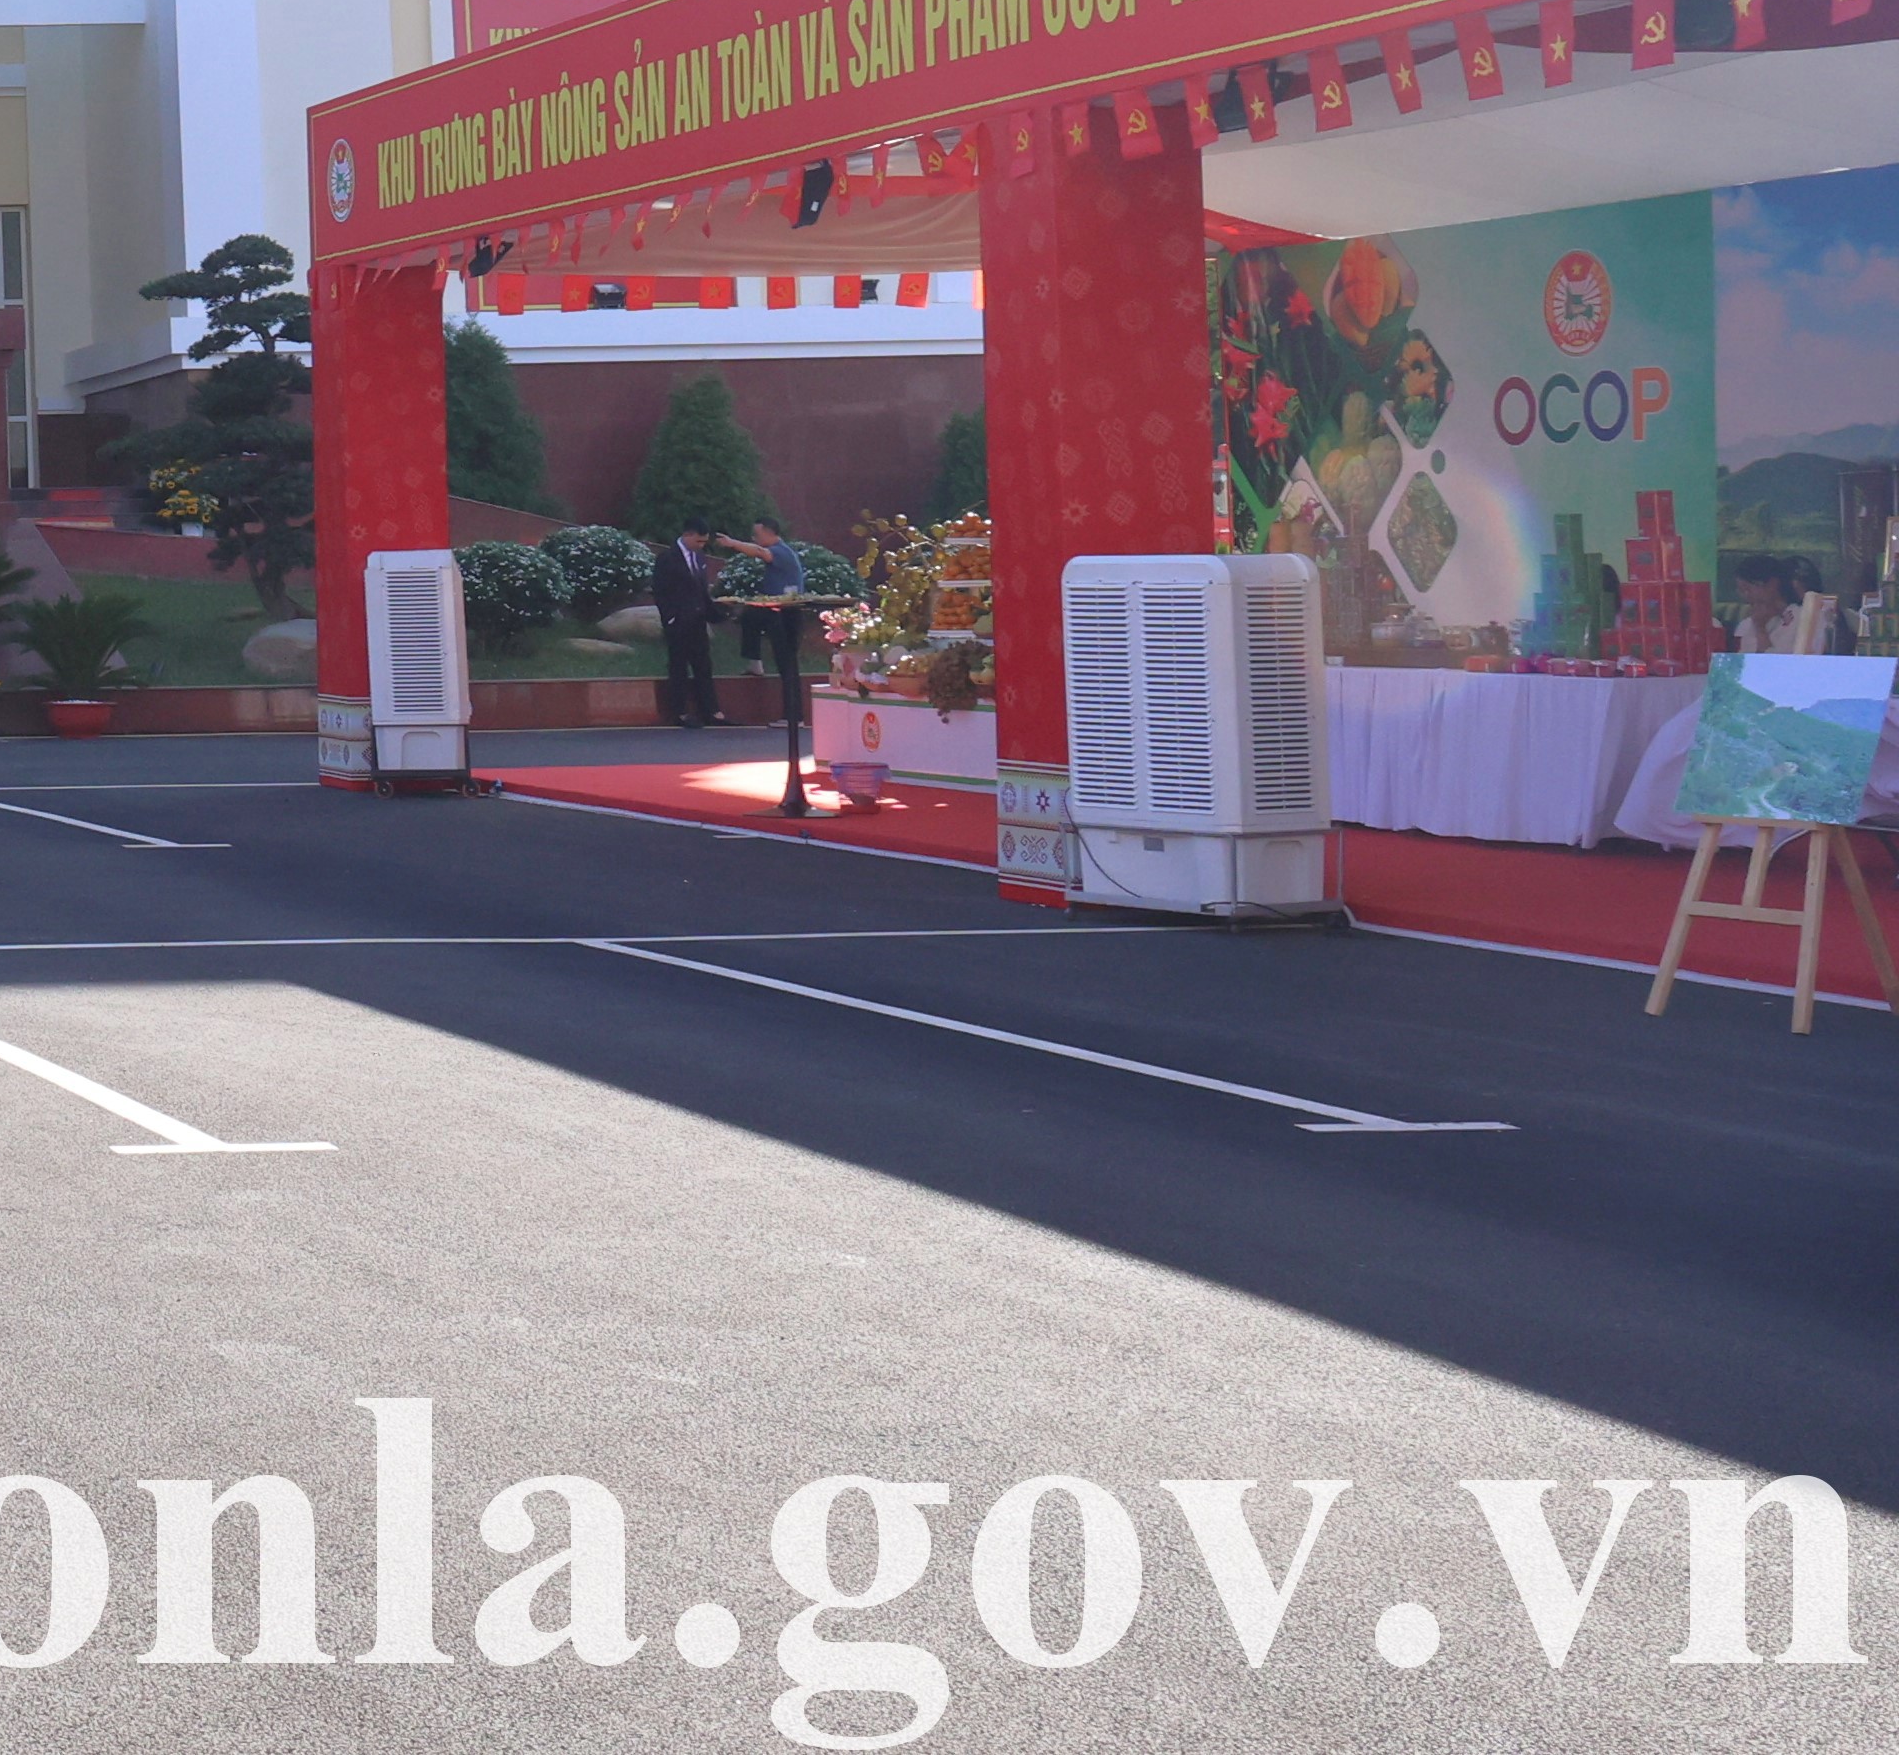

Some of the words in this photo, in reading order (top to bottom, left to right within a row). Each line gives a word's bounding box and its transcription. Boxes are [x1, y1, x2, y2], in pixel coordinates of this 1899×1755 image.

[378, 140, 415, 208] KHU
[420, 113, 486, 198] TRƯNG
[492, 88, 533, 180] BÀY
[541, 72, 606, 168] NÔNG
[614, 39, 665, 150] SẢN
[674, 46, 710, 135] AN
[717, 10, 791, 122] TOÀN
[1493, 365, 1670, 447] OCOP
